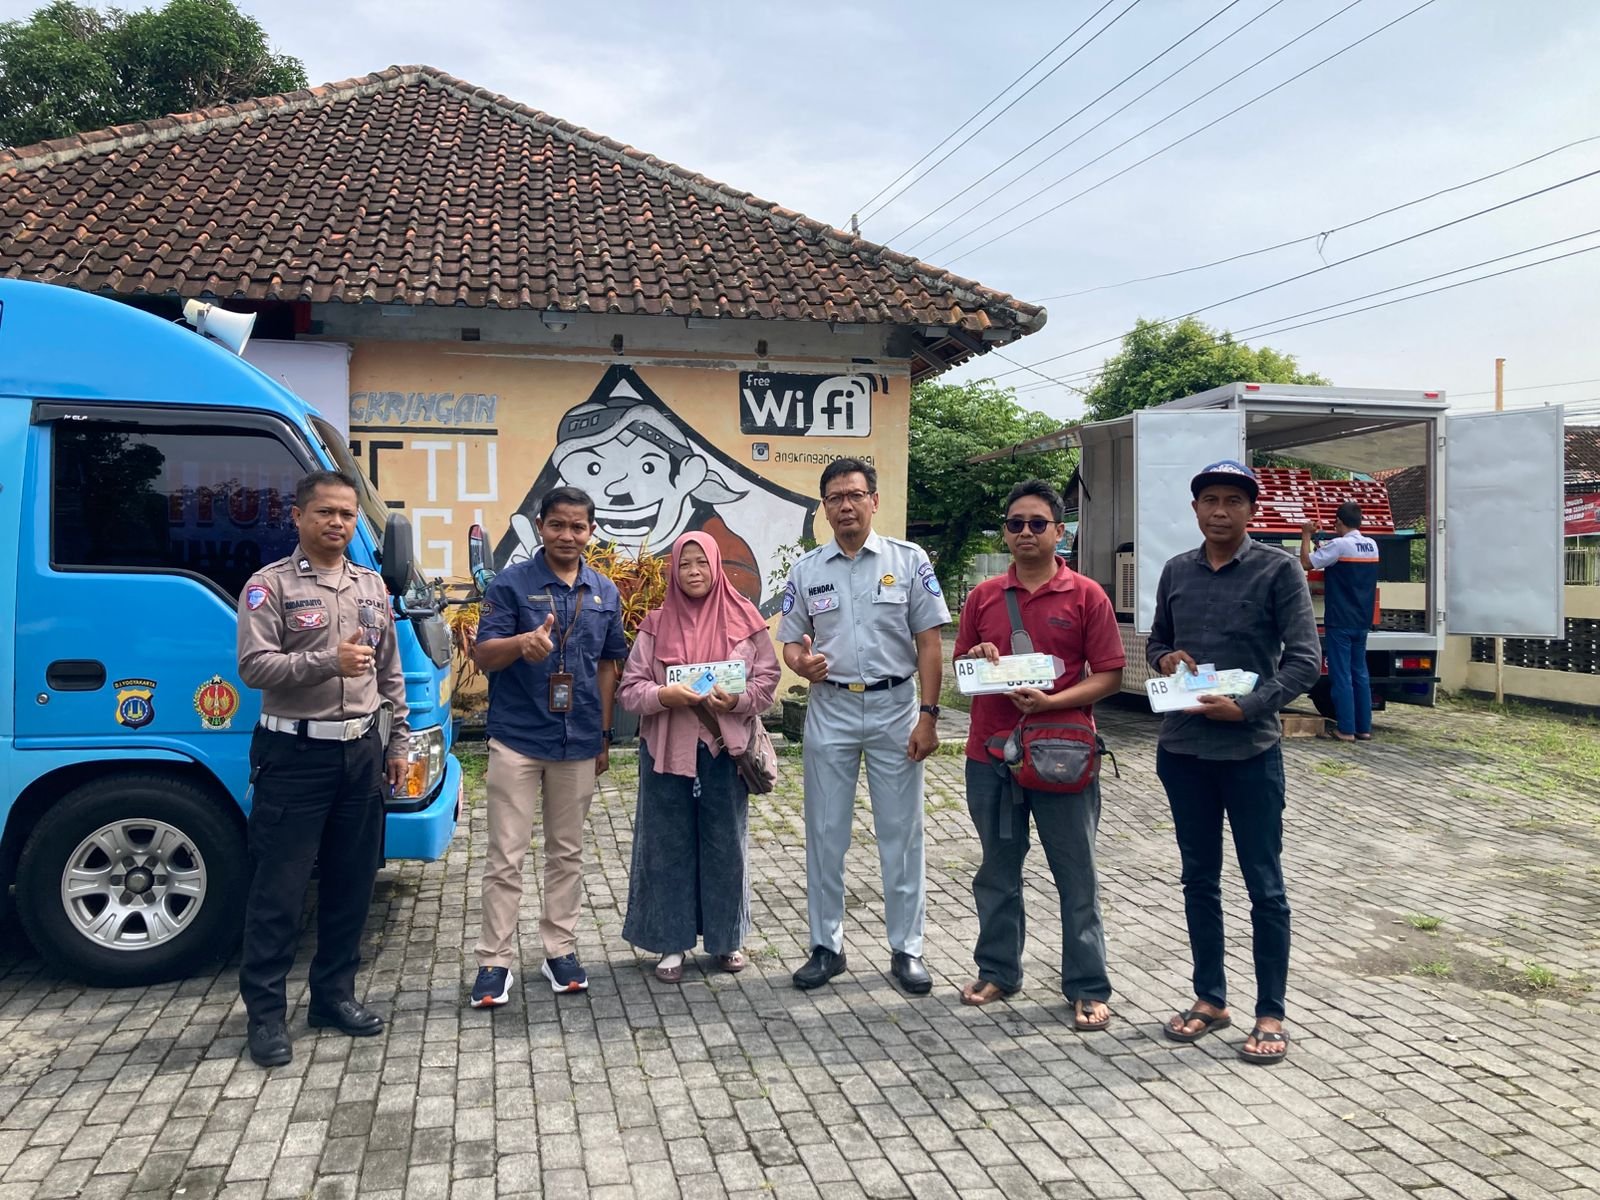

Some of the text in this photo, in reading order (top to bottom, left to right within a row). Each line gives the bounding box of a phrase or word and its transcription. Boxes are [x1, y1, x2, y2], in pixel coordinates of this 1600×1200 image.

[745, 374, 770, 387] free
[774, 451, 875, 466] angkringansegi
[1355, 543, 1374, 553] TNKB
[808, 583, 835, 597] HENDRA
[957, 662, 976, 677] AB
[1150, 681, 1169, 695] AB
